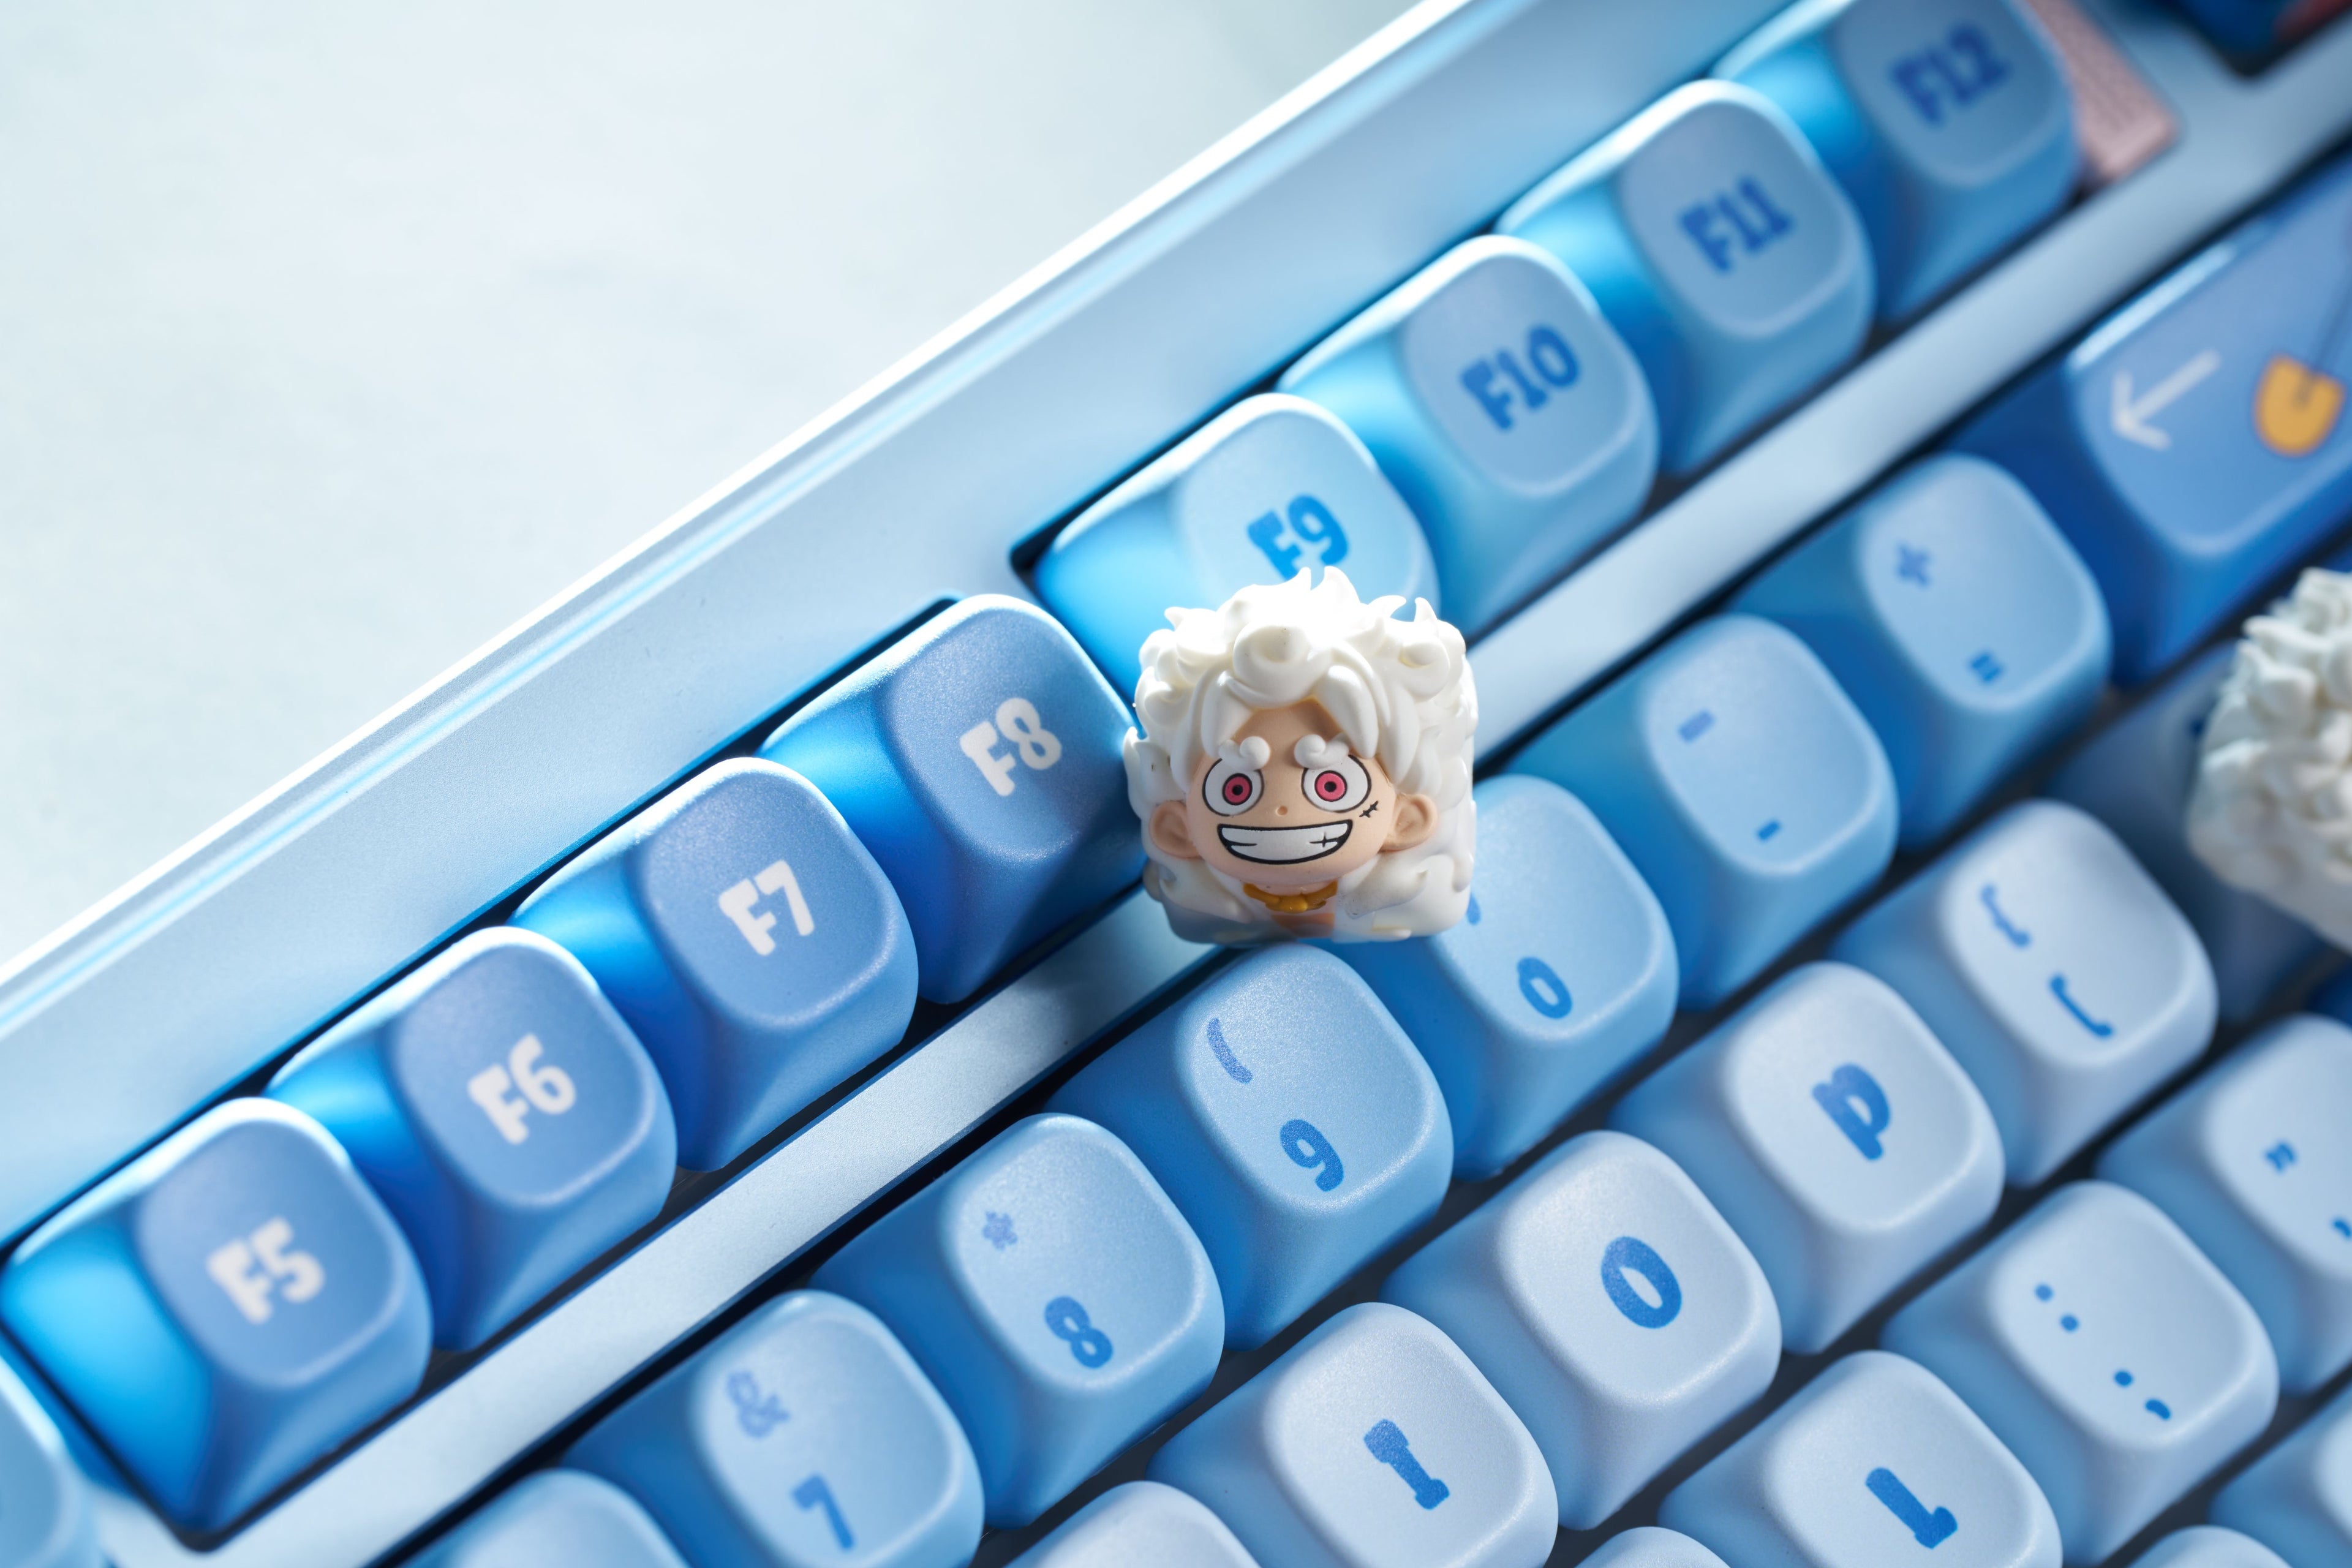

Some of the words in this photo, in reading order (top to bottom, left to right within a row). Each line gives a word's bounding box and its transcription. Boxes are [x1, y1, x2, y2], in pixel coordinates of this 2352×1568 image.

[1891, 21, 2010, 124] F12
[1681, 178, 1796, 271] F11
[1462, 325, 1581, 430] F10
[1247, 494, 1350, 581] F9
[959, 697, 1061, 796] F8
[718, 861, 813, 956] F7
[1517, 958, 1572, 1019] 0
[467, 1035, 574, 1144] F6
[1207, 1018, 1253, 1084] (
[1280, 1120, 1344, 1192] 9
[1814, 1065, 1891, 1161] P
[206, 1219, 322, 1322] F5
[1602, 1237, 1682, 1329] O
[1045, 1297, 1114, 1369] 8
[726, 1371, 791, 1439] &
[1364, 1420, 1450, 1510] I
[1866, 1468, 1958, 1549] L
[794, 1476, 854, 1550] 7
